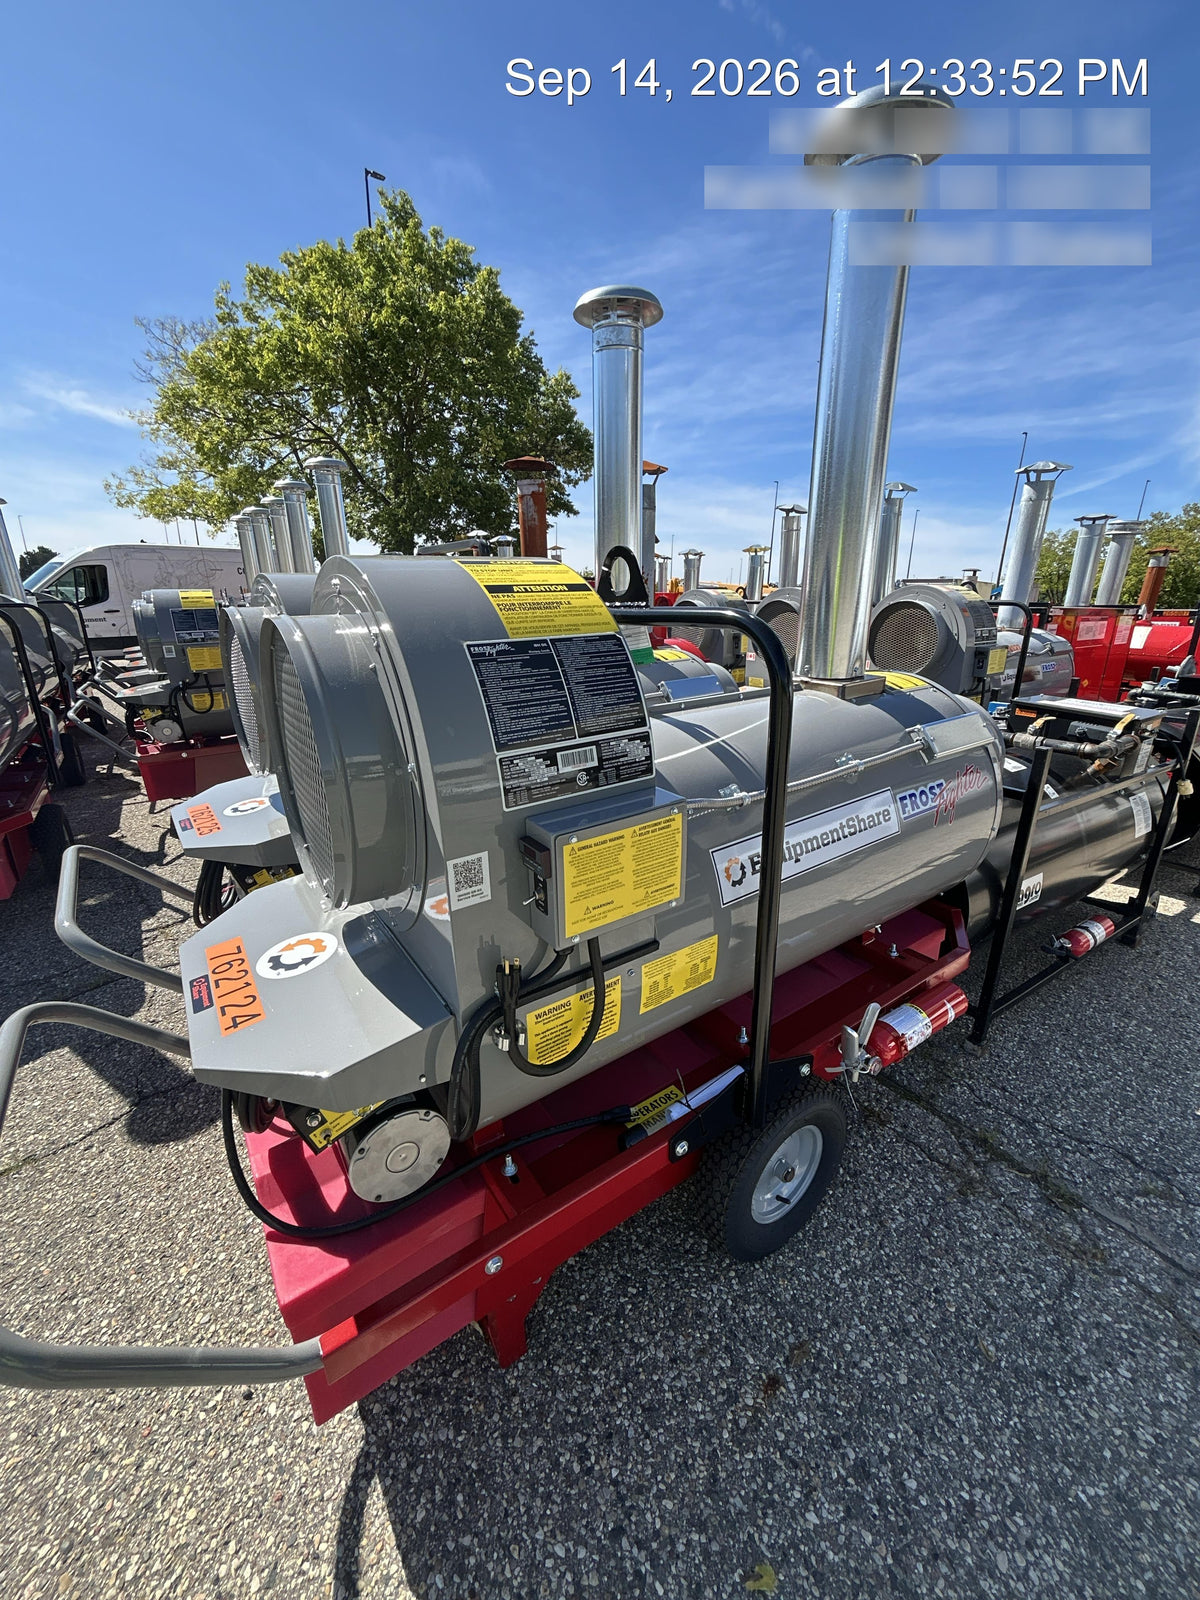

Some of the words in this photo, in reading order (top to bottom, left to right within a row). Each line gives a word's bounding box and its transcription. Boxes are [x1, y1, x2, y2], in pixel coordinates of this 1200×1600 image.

[898, 782, 945, 815] FROST
[933, 764, 988, 826] Fighter
[190, 806, 220, 836] 762125
[748, 807, 892, 876] EipmentShare
[210, 946, 262, 1030] 762124
[534, 1000, 571, 1020] WARNING
[579, 979, 620, 1002] AVERMENT
